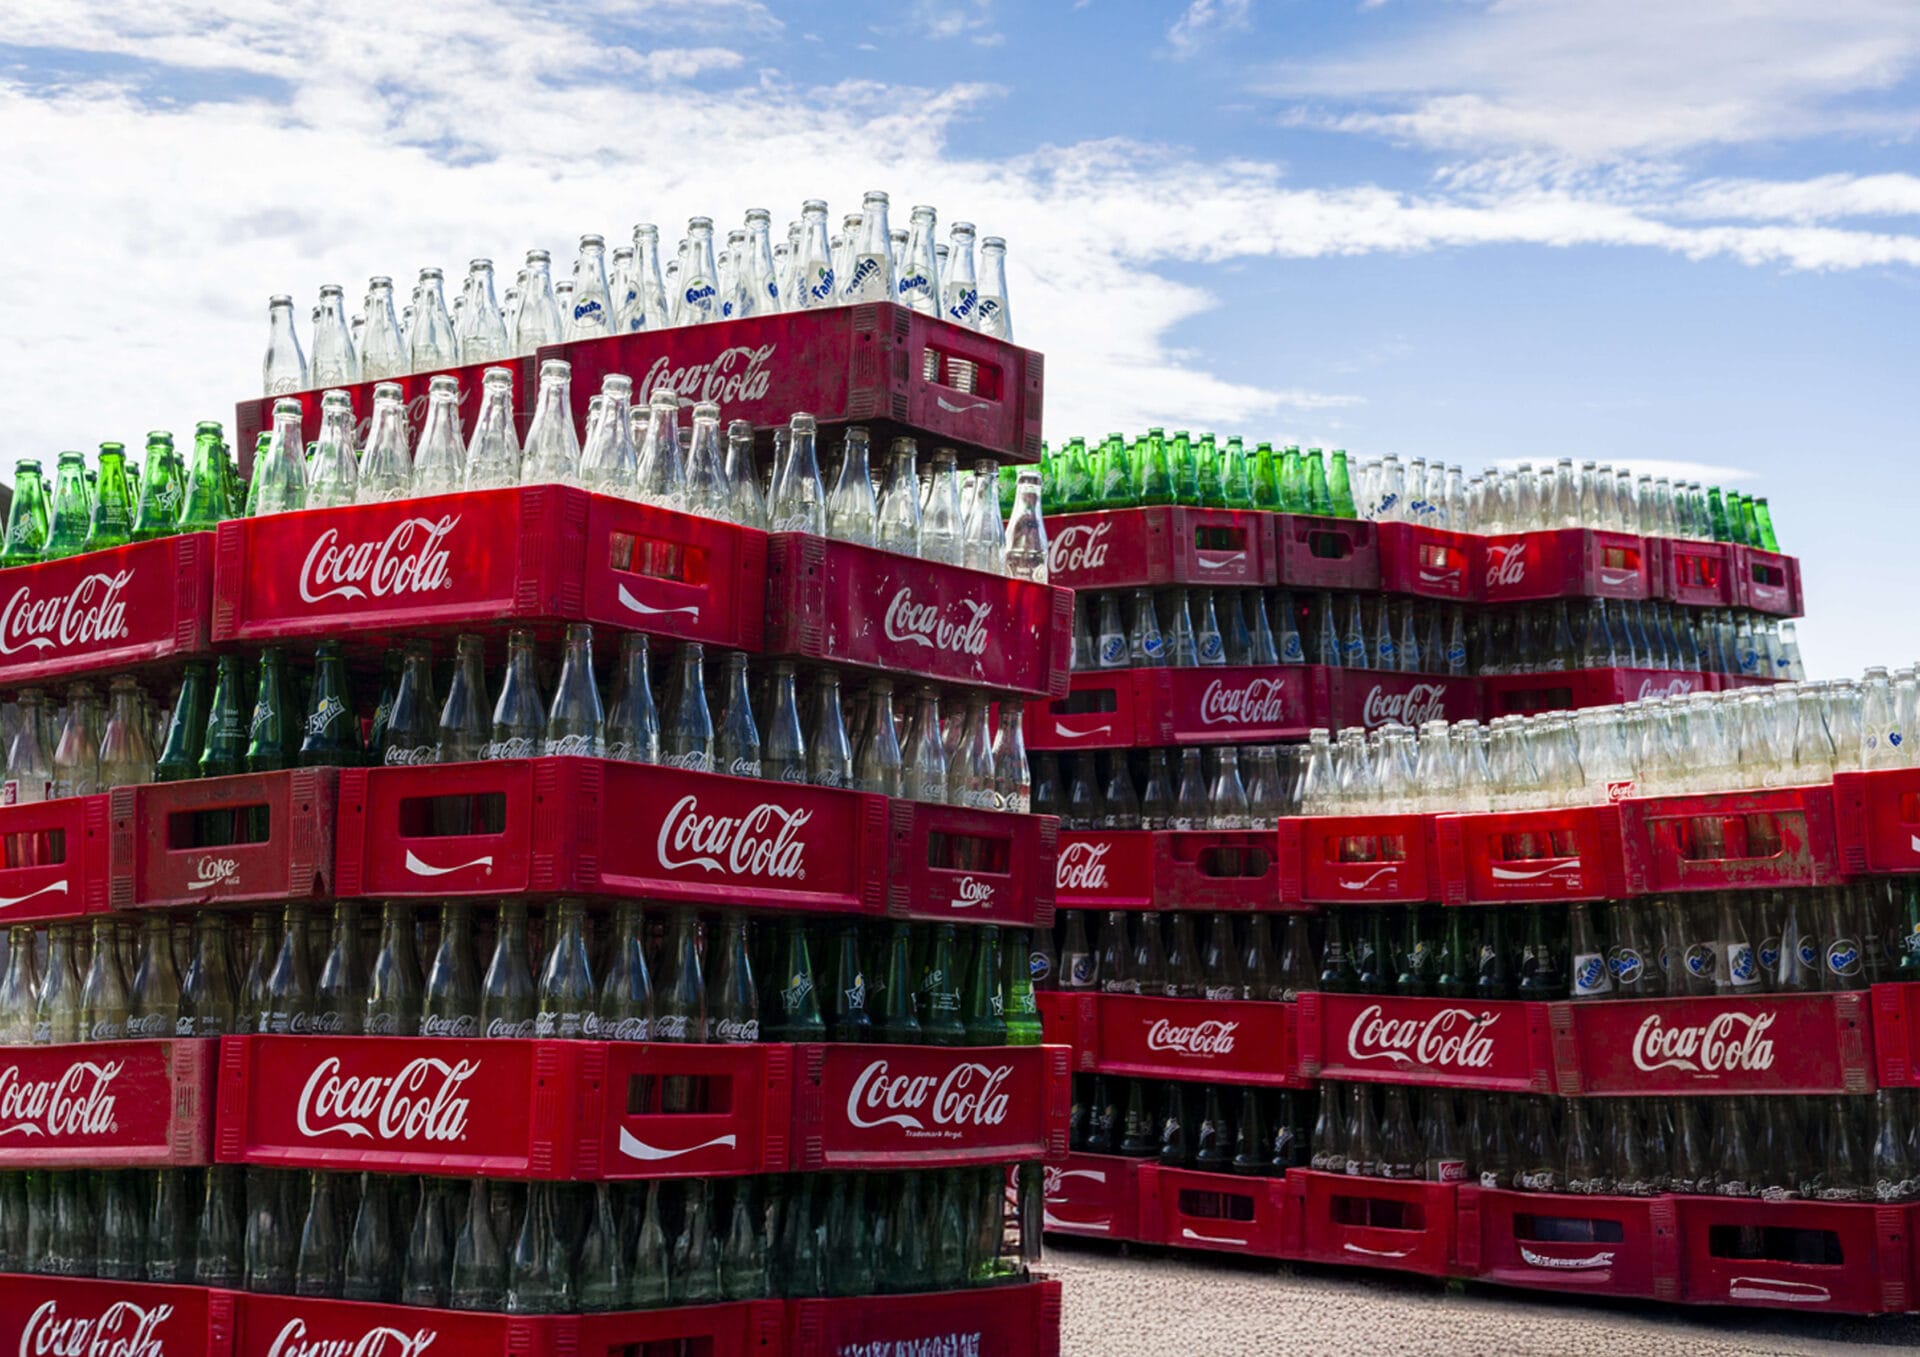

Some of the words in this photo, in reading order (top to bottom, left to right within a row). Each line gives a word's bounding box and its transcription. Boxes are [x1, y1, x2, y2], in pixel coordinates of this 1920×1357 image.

[639, 342, 777, 408] Coca-Cola
[300, 514, 462, 603] Coca-Cola
[0, 568, 135, 655] Coca-Cola
[884, 586, 993, 655] CocaCola
[312, 700, 342, 732] Sprite
[1201, 678, 1284, 724] Coca-Cola
[1363, 684, 1447, 728] Coca-Cola
[197, 855, 240, 881] Coke
[657, 795, 813, 879] Coca-Cola
[959, 876, 995, 900] Coke
[1147, 1018, 1240, 1054] Coca-Cola
[1347, 1004, 1501, 1068] Coca-Cola
[1632, 1012, 1777, 1072] Coca-Cola
[0, 1060, 125, 1138] Coca-Cola
[297, 1056, 482, 1142] Coca-Cola
[847, 1060, 1015, 1129] Coca-Cola
[905, 1130, 942, 1138] Trademark
